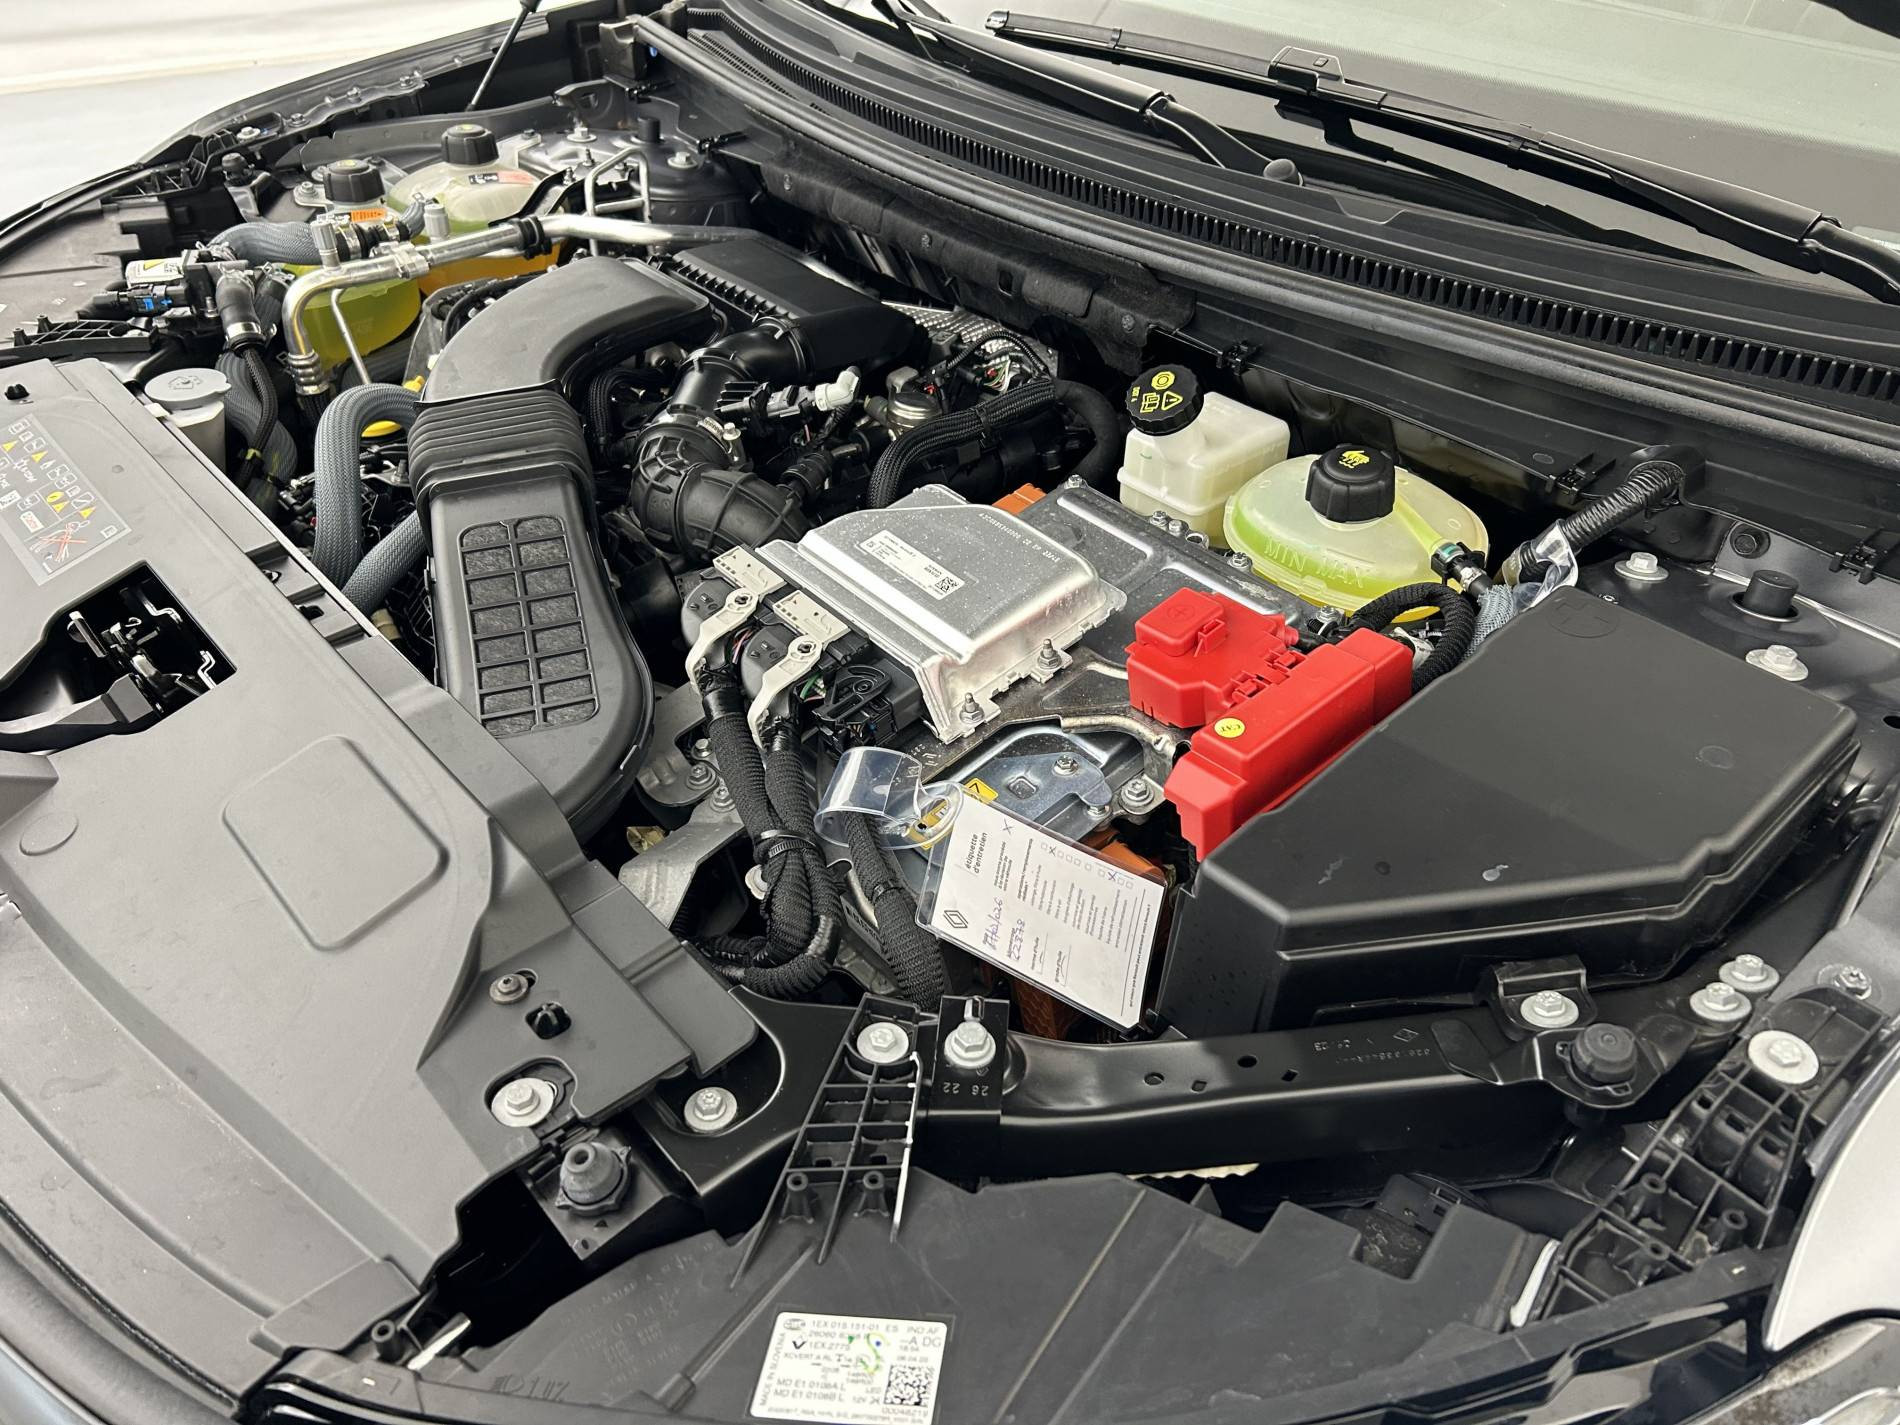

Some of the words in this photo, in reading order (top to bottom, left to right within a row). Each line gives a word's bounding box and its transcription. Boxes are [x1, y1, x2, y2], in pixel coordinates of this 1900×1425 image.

[1264, 538, 1307, 572] MIN
[965, 834, 978, 869] étiquette
[973, 832, 988, 873] d'entretien
[944, 1082, 960, 1094] 22
